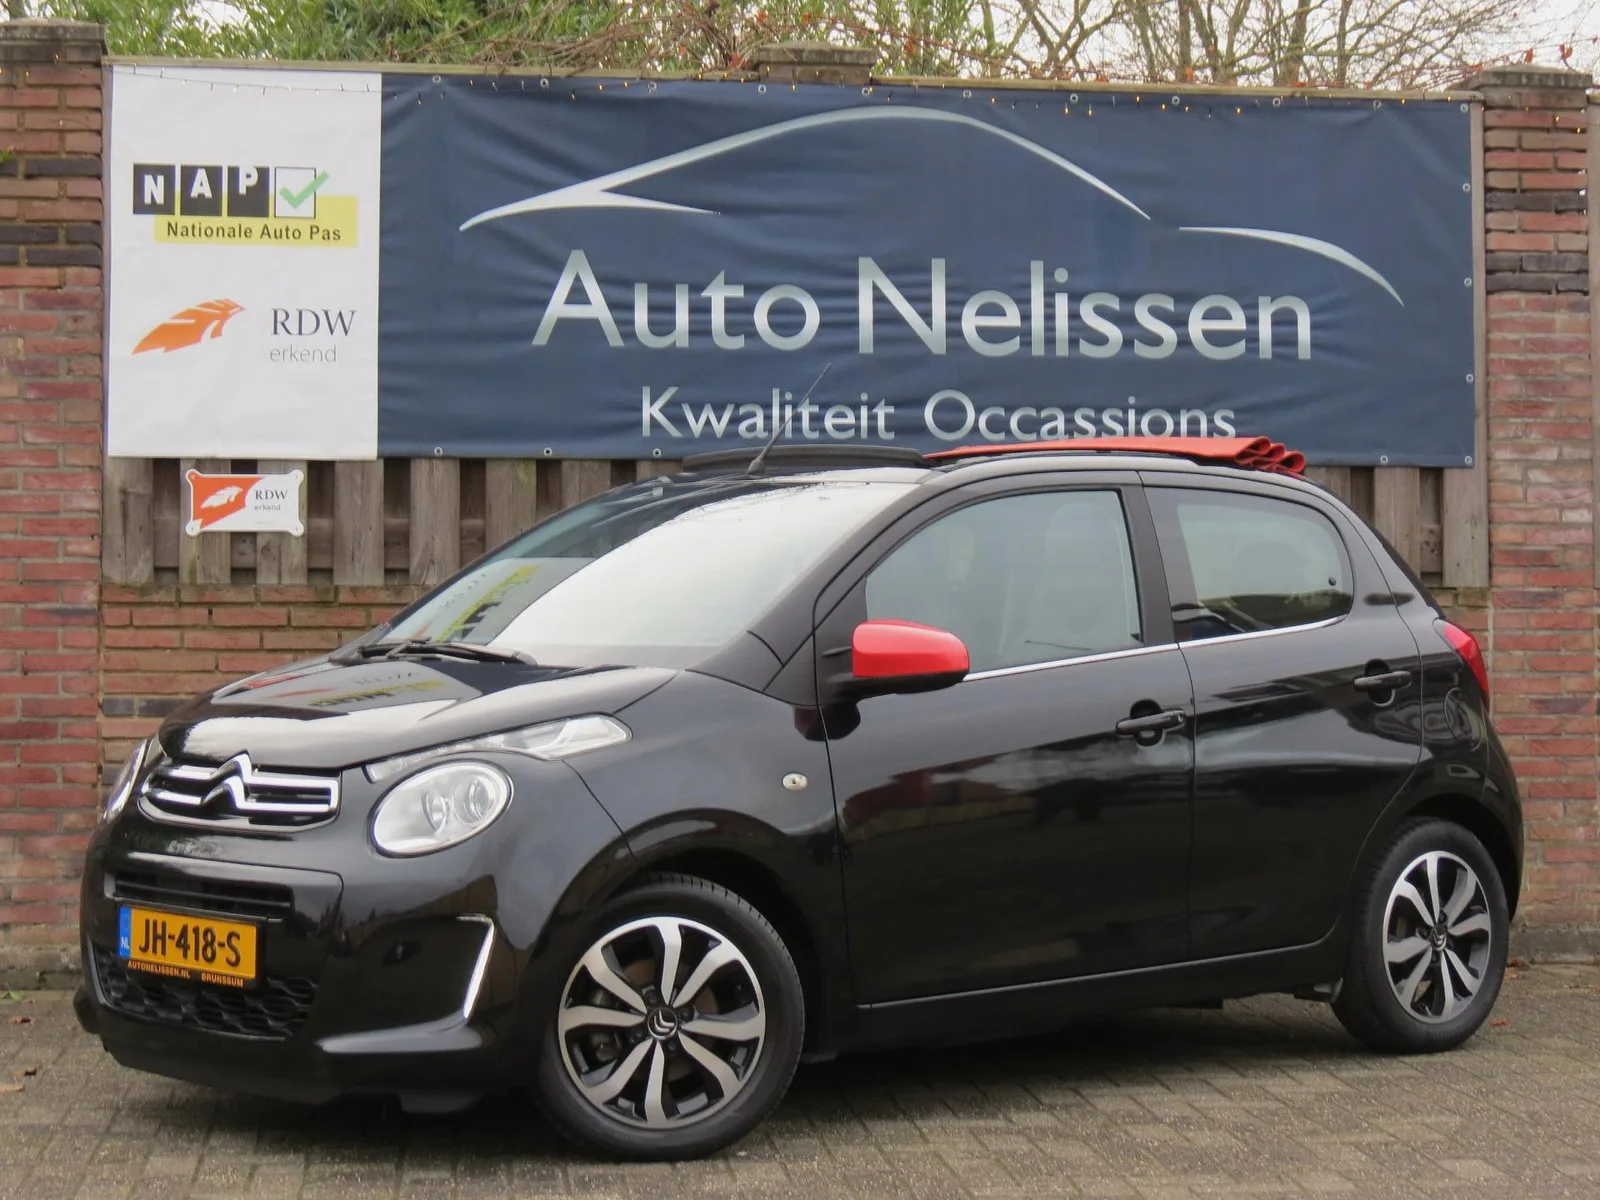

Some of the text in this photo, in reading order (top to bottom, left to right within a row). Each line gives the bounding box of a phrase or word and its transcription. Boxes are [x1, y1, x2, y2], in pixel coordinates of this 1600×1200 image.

[144, 167, 258, 205] NAP
[167, 221, 341, 240] Nationale Auto Pas
[531, 249, 1311, 360] Auto Nelissen
[271, 308, 357, 336] RDW
[269, 345, 337, 363] erkend
[641, 386, 1236, 440] Kwaliteit Occassions
[255, 490, 288, 500] RDW
[121, 937, 130, 948] NL
[139, 919, 240, 967] JH-418-S
[127, 960, 244, 987] AUTONELISSEN.NL BRUNSSUM
